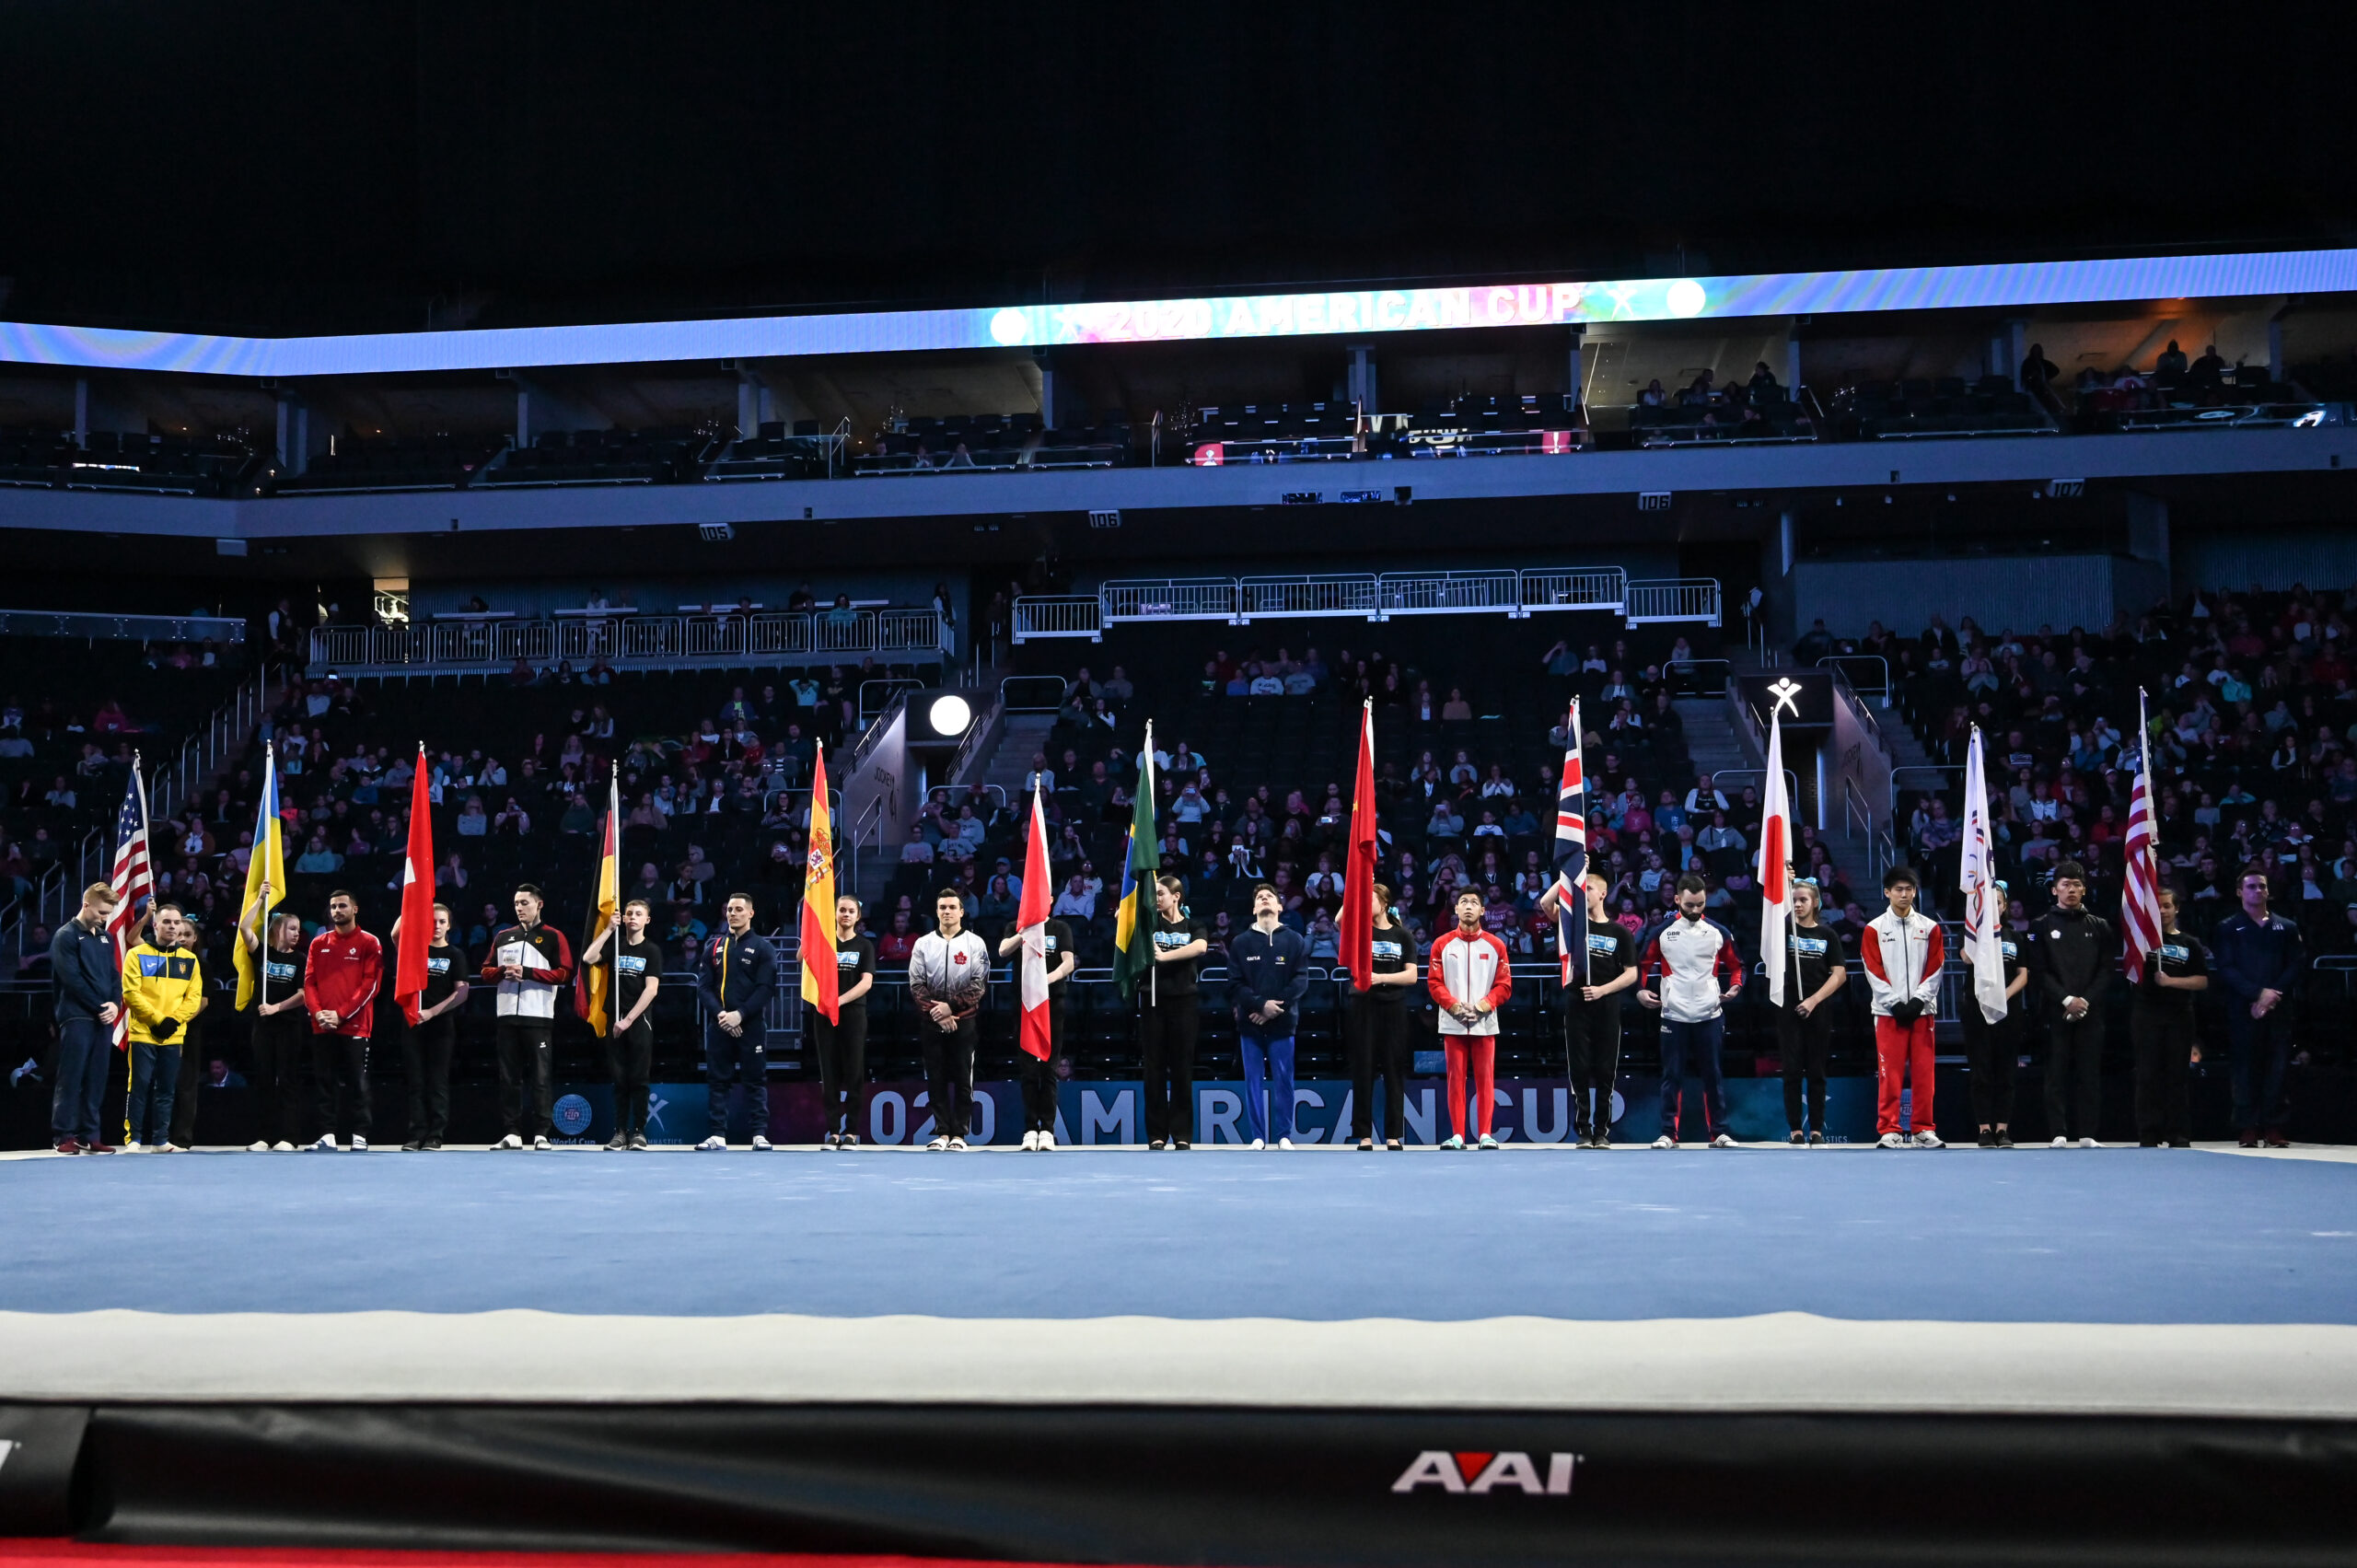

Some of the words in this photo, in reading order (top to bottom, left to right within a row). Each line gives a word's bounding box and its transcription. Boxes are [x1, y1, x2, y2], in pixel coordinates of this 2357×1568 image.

[1108, 300, 1213, 340] 2020
[1223, 288, 1471, 335] AMERICAN
[1487, 285, 1582, 323] CUP
[2054, 482, 2083, 497] 107
[1642, 494, 1670, 509] 106
[1090, 513, 1119, 528] 106
[701, 527, 728, 540] 105
[874, 765, 895, 789] JOCKEY
[825, 1089, 995, 1145] 020
[1038, 1088, 1436, 1145] MRICAN
[1391, 1450, 1575, 1494] AAI
